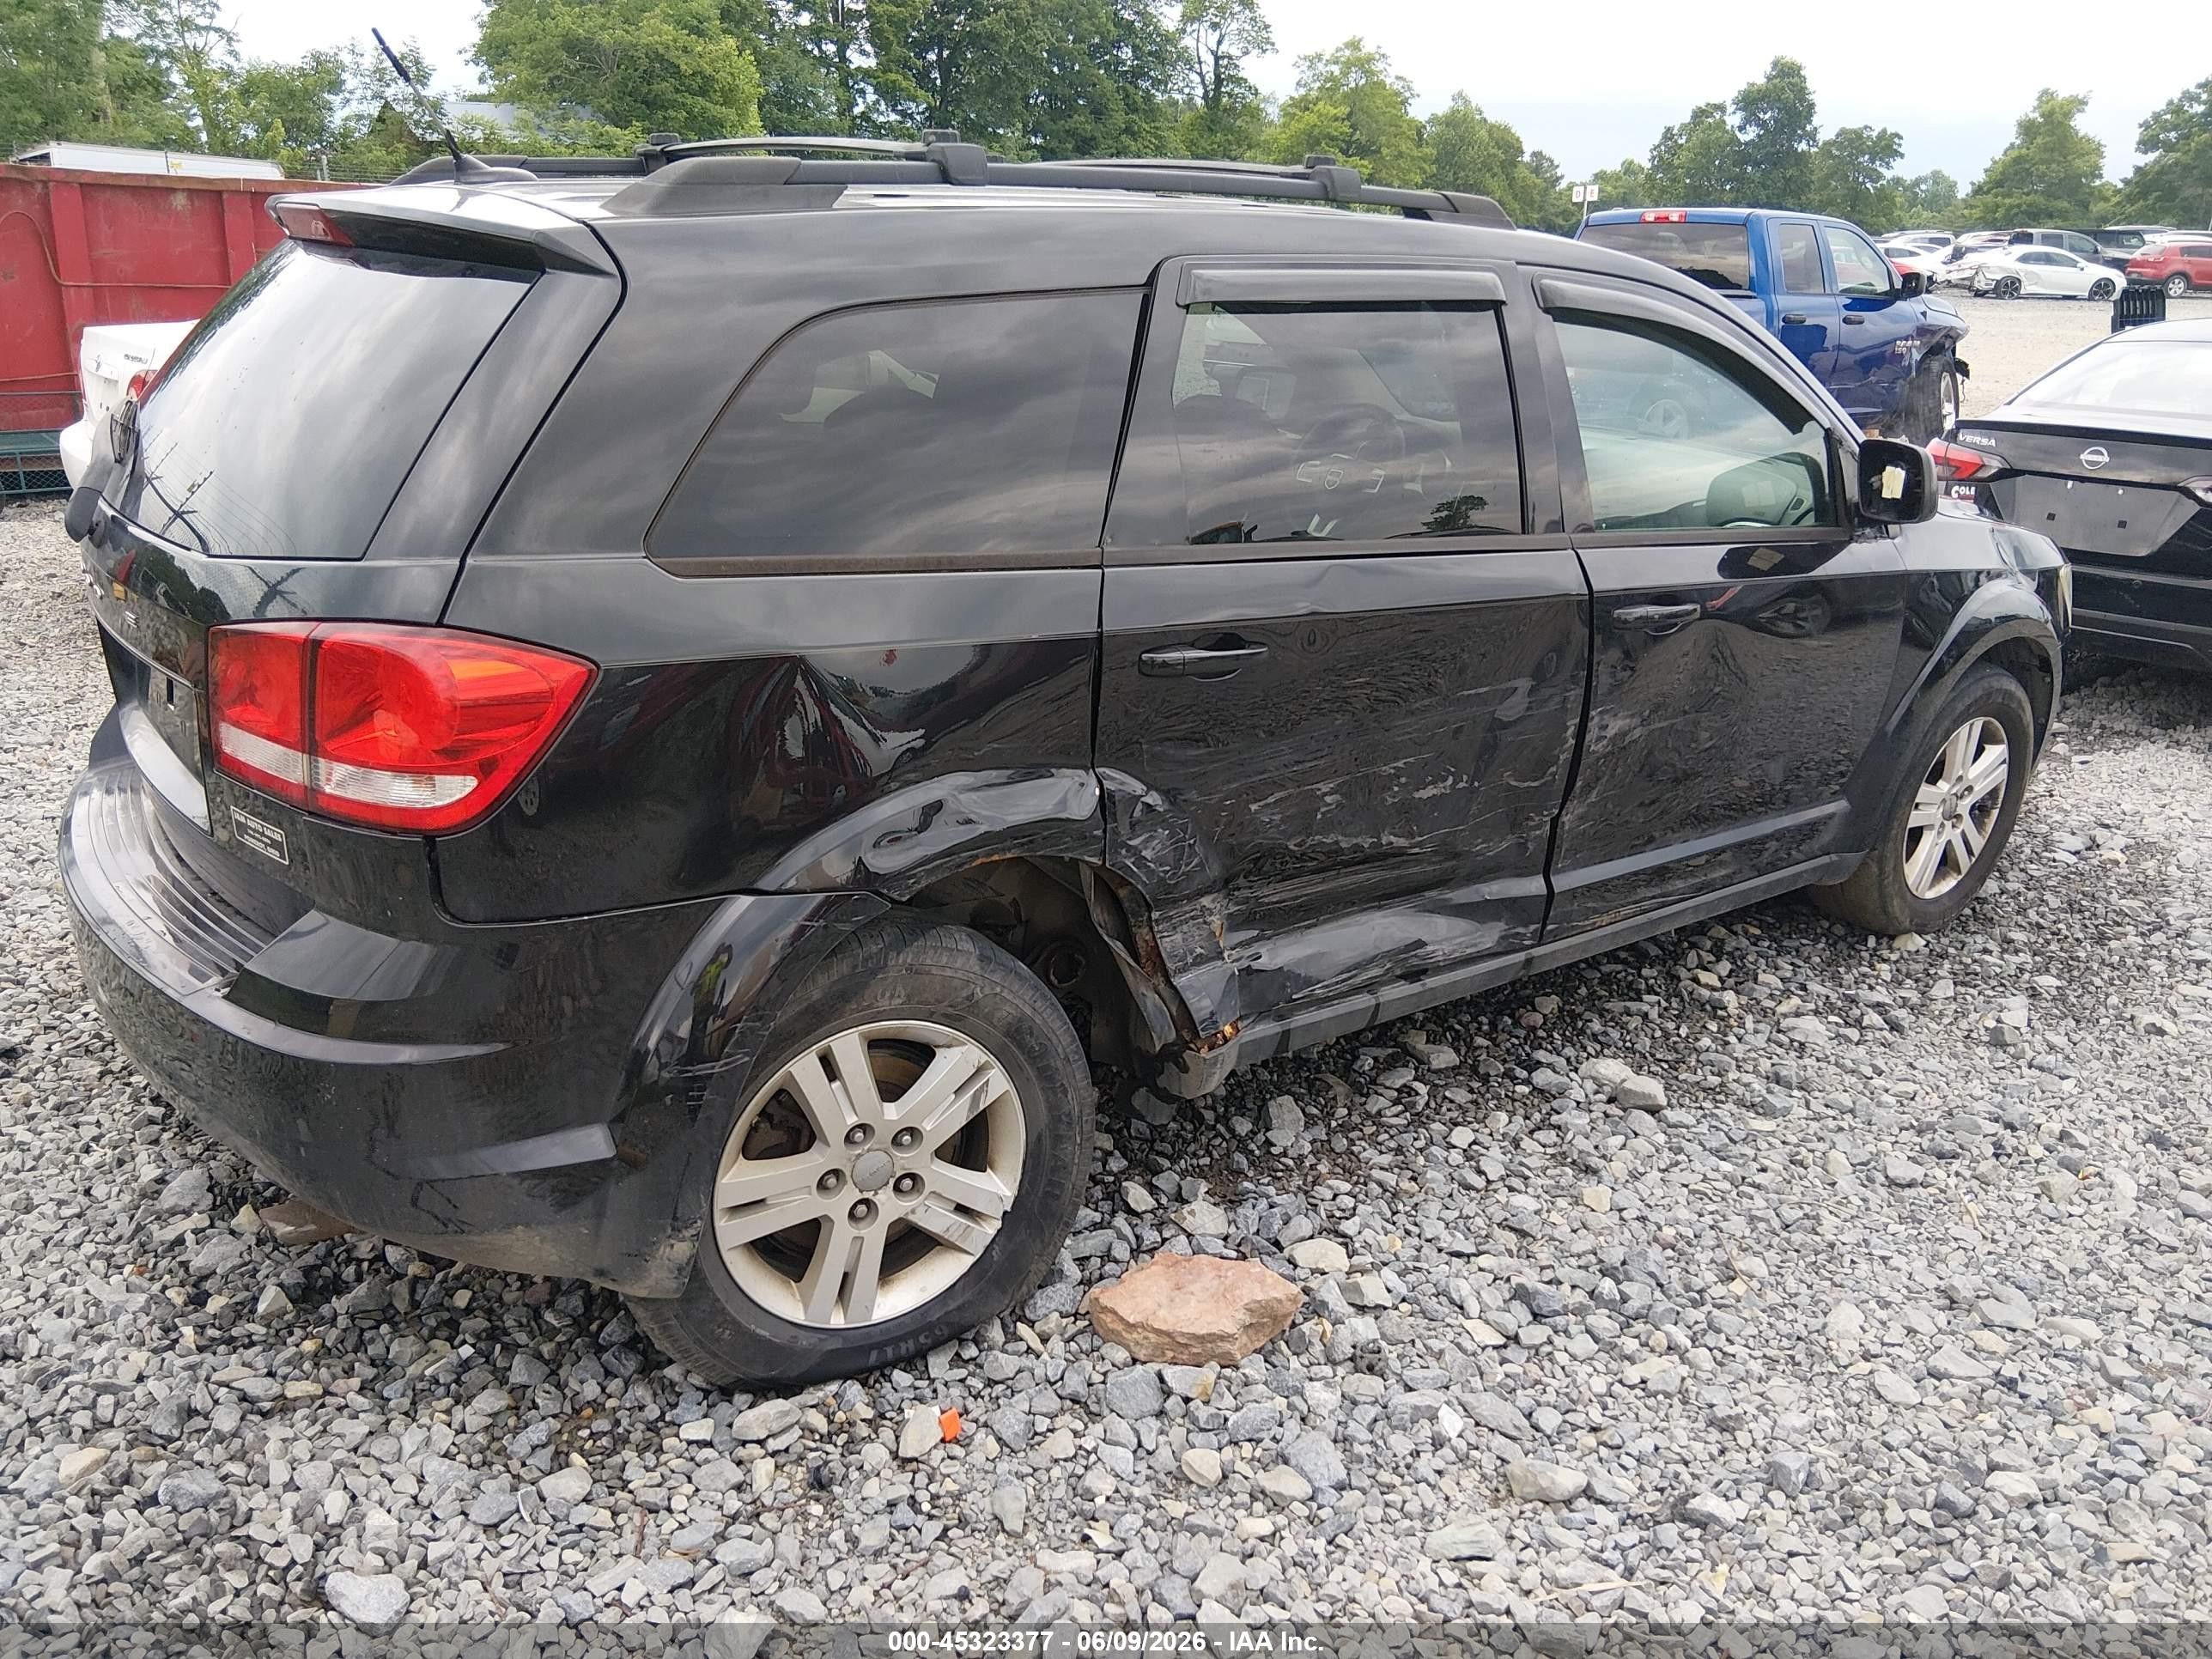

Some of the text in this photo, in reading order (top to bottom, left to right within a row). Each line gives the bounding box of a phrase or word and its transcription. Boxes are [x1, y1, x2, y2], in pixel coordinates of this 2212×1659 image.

[1958, 432, 1996, 447] VERSA
[247, 818, 263, 833] AUTO
[263, 827, 283, 842] SALES
